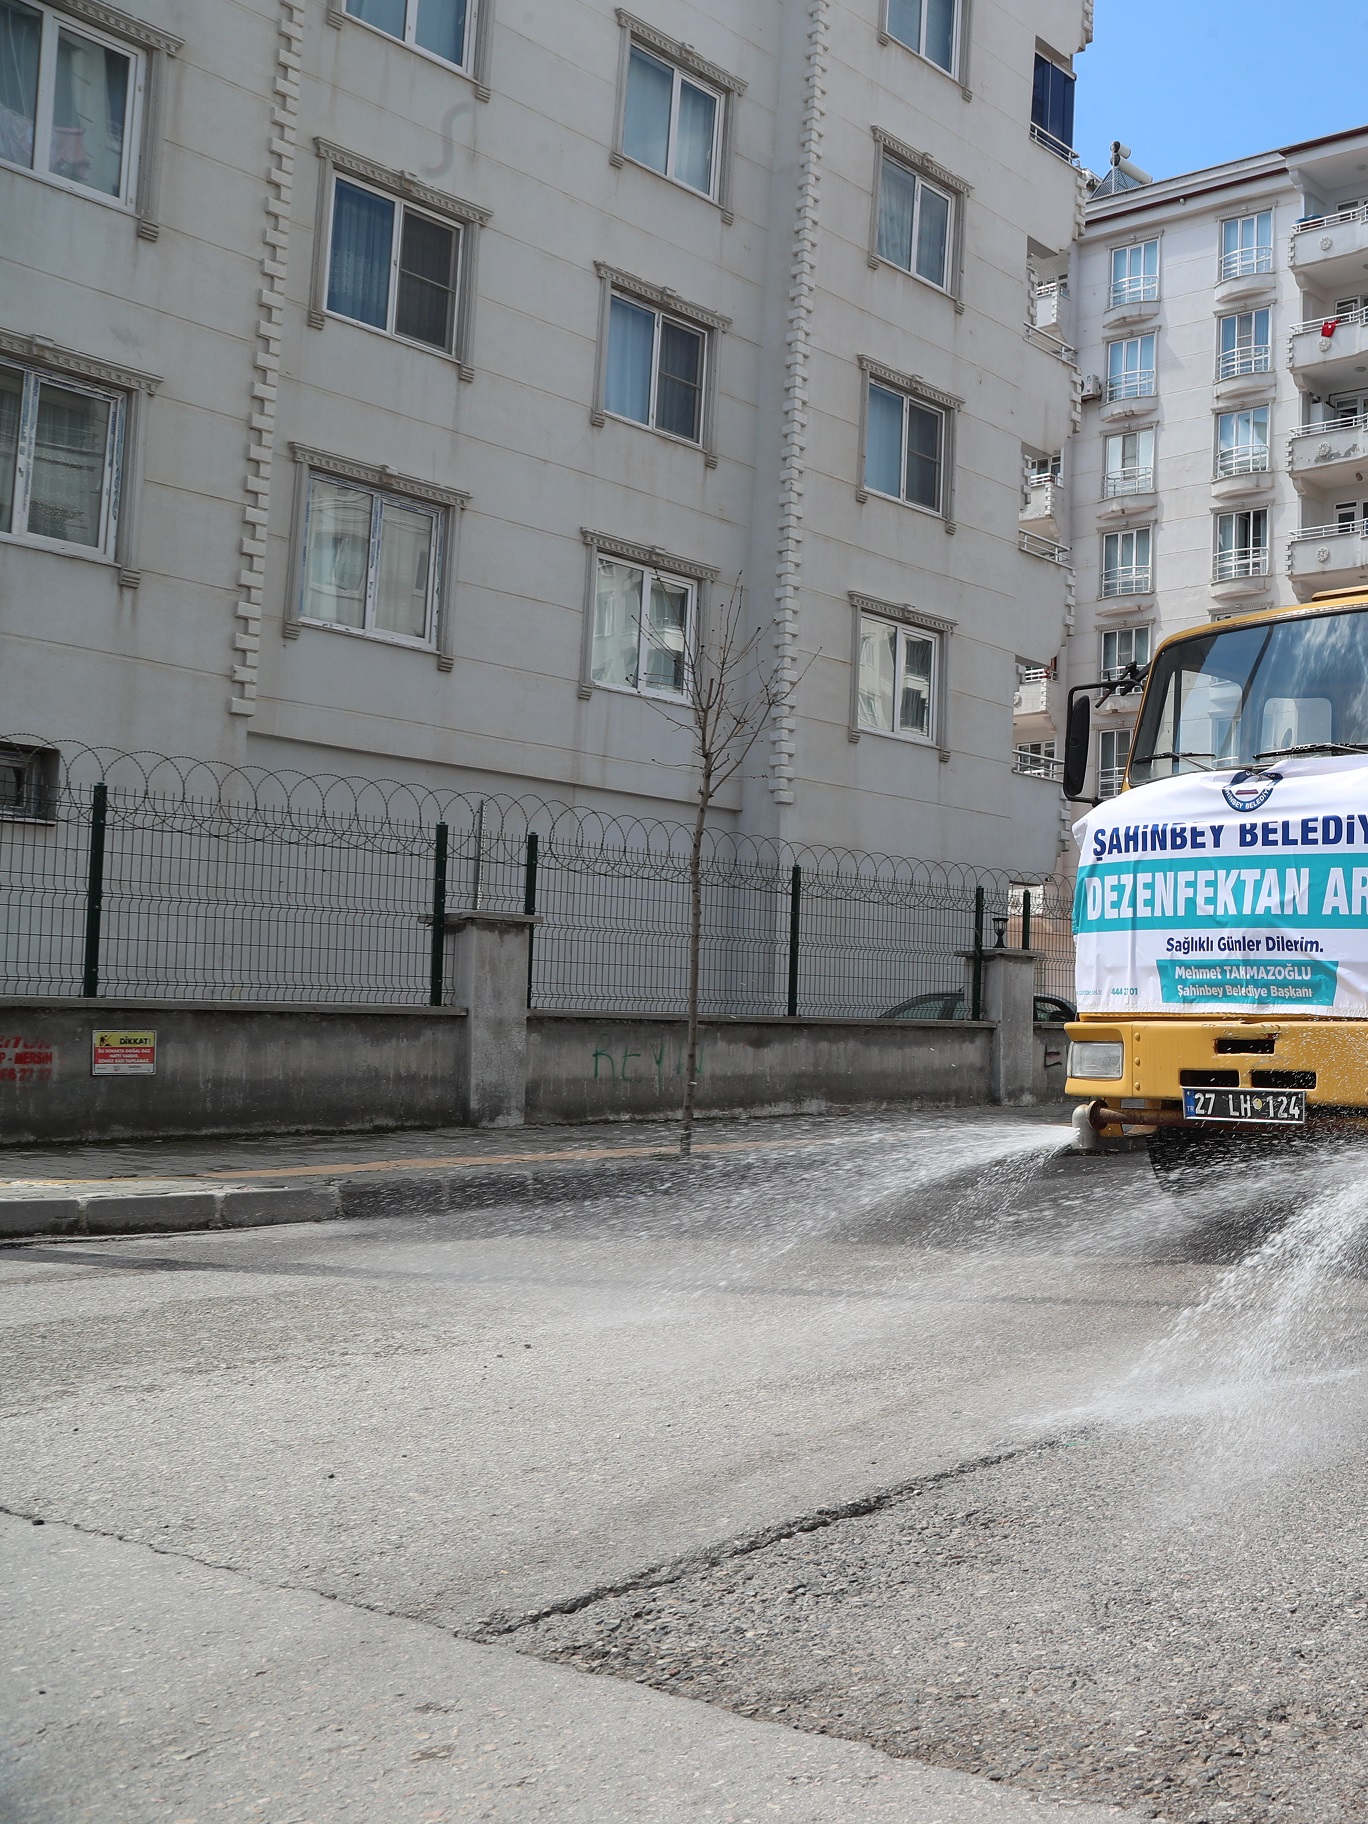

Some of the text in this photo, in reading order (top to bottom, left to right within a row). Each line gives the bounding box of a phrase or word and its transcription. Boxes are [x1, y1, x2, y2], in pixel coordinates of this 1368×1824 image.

[1084, 867, 1310, 921] DEZENFEKTAN
[1166, 936, 1324, 955] Sağlıklı Günler Dilerim.
[1175, 963, 1312, 981] Mehmet TAHMAZOĞLU
[1177, 984, 1313, 999] Şahinbey Belediye Başkanı
[1186, 1105, 1195, 1113] TR
[1194, 1092, 1300, 1119] 27 LH 124
